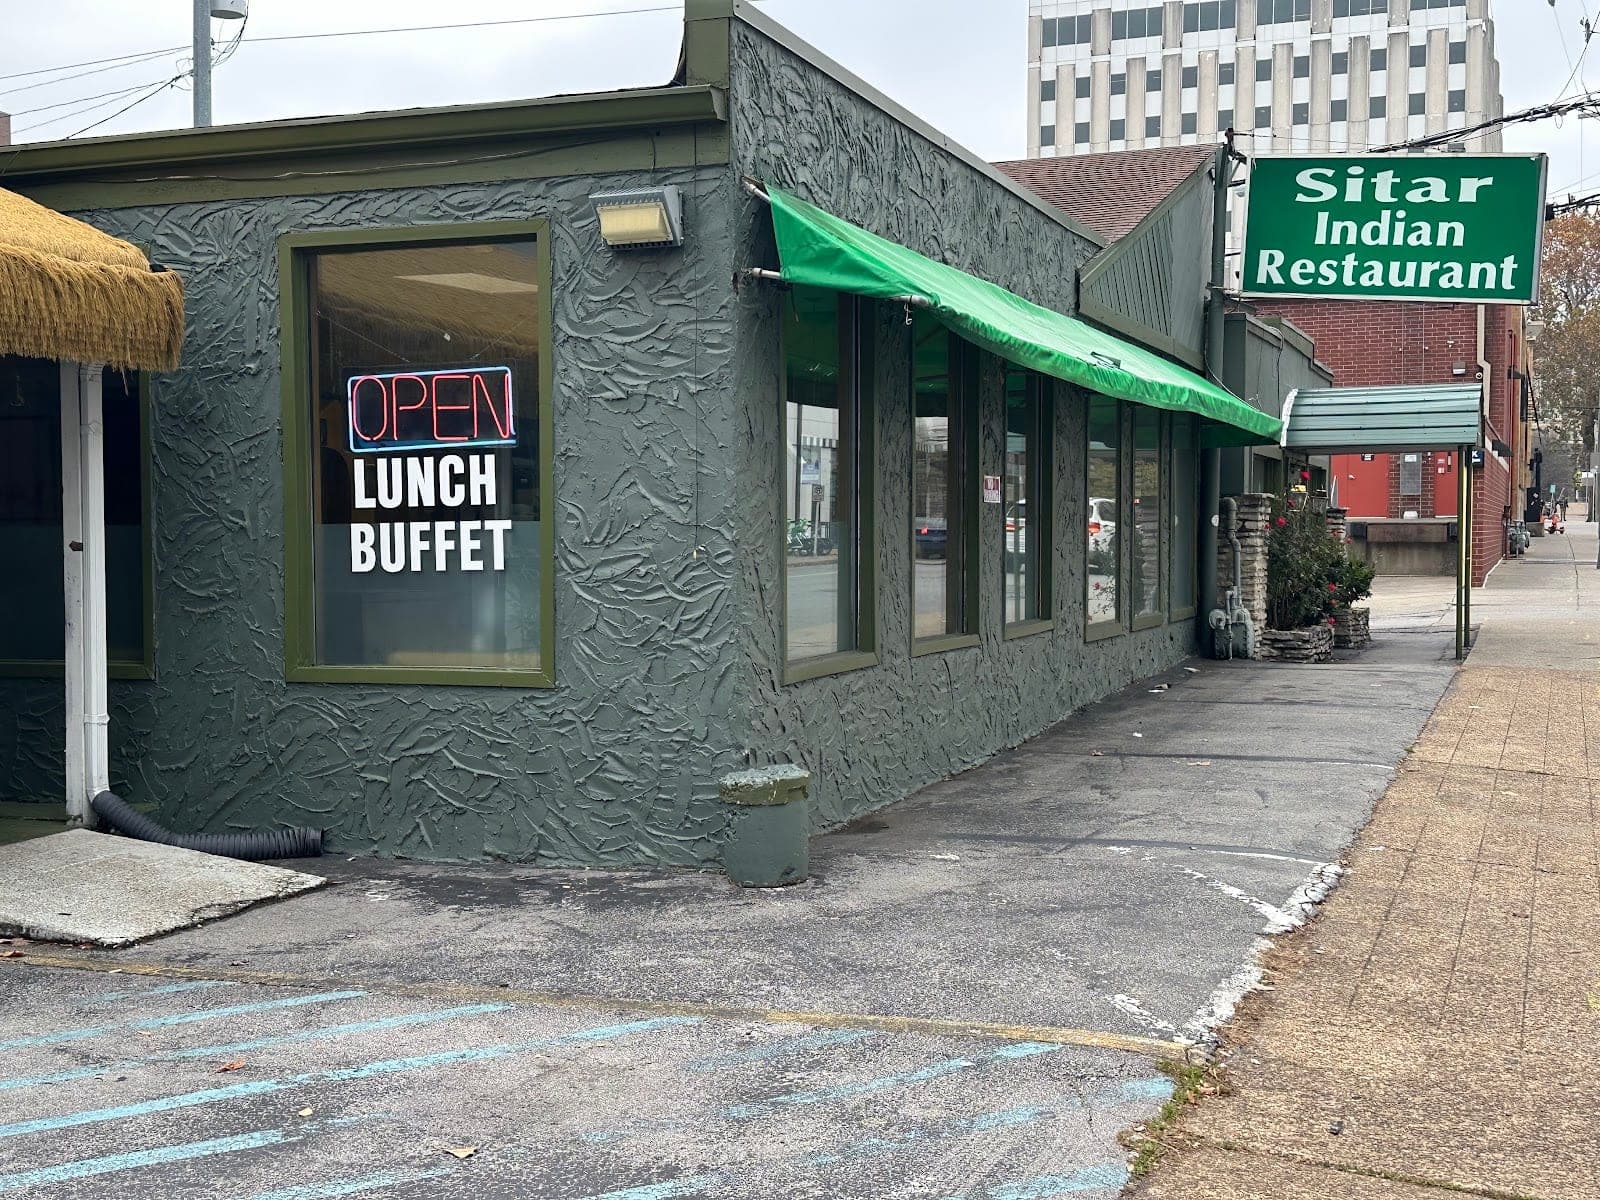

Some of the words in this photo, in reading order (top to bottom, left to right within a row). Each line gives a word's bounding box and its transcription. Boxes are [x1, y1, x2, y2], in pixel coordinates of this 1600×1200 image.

[1295, 165, 1493, 203] Sitar
[1314, 209, 1465, 246] Indian
[1256, 249, 1518, 290] Restaurant
[352, 374, 510, 441] OPEN
[353, 454, 497, 509] LUNCH
[350, 519, 512, 573] BUFFET
